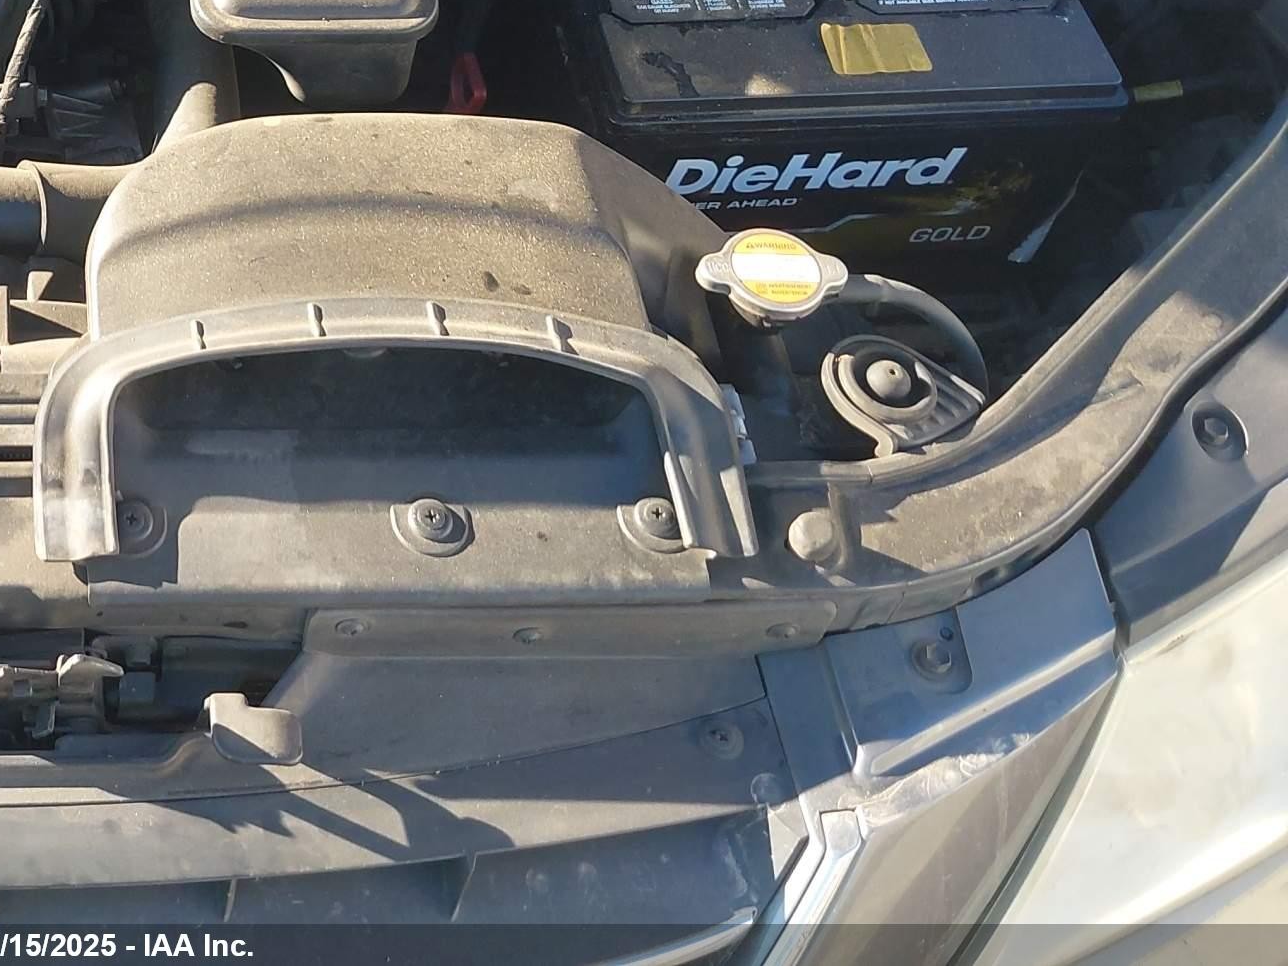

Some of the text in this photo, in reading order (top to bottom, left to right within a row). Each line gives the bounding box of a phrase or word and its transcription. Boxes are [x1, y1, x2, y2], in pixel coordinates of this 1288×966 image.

[664, 147, 968, 196] DieHard
[726, 197, 798, 209] AHEAD
[909, 225, 991, 243] GOLD
[755, 241, 797, 250] WARNING
